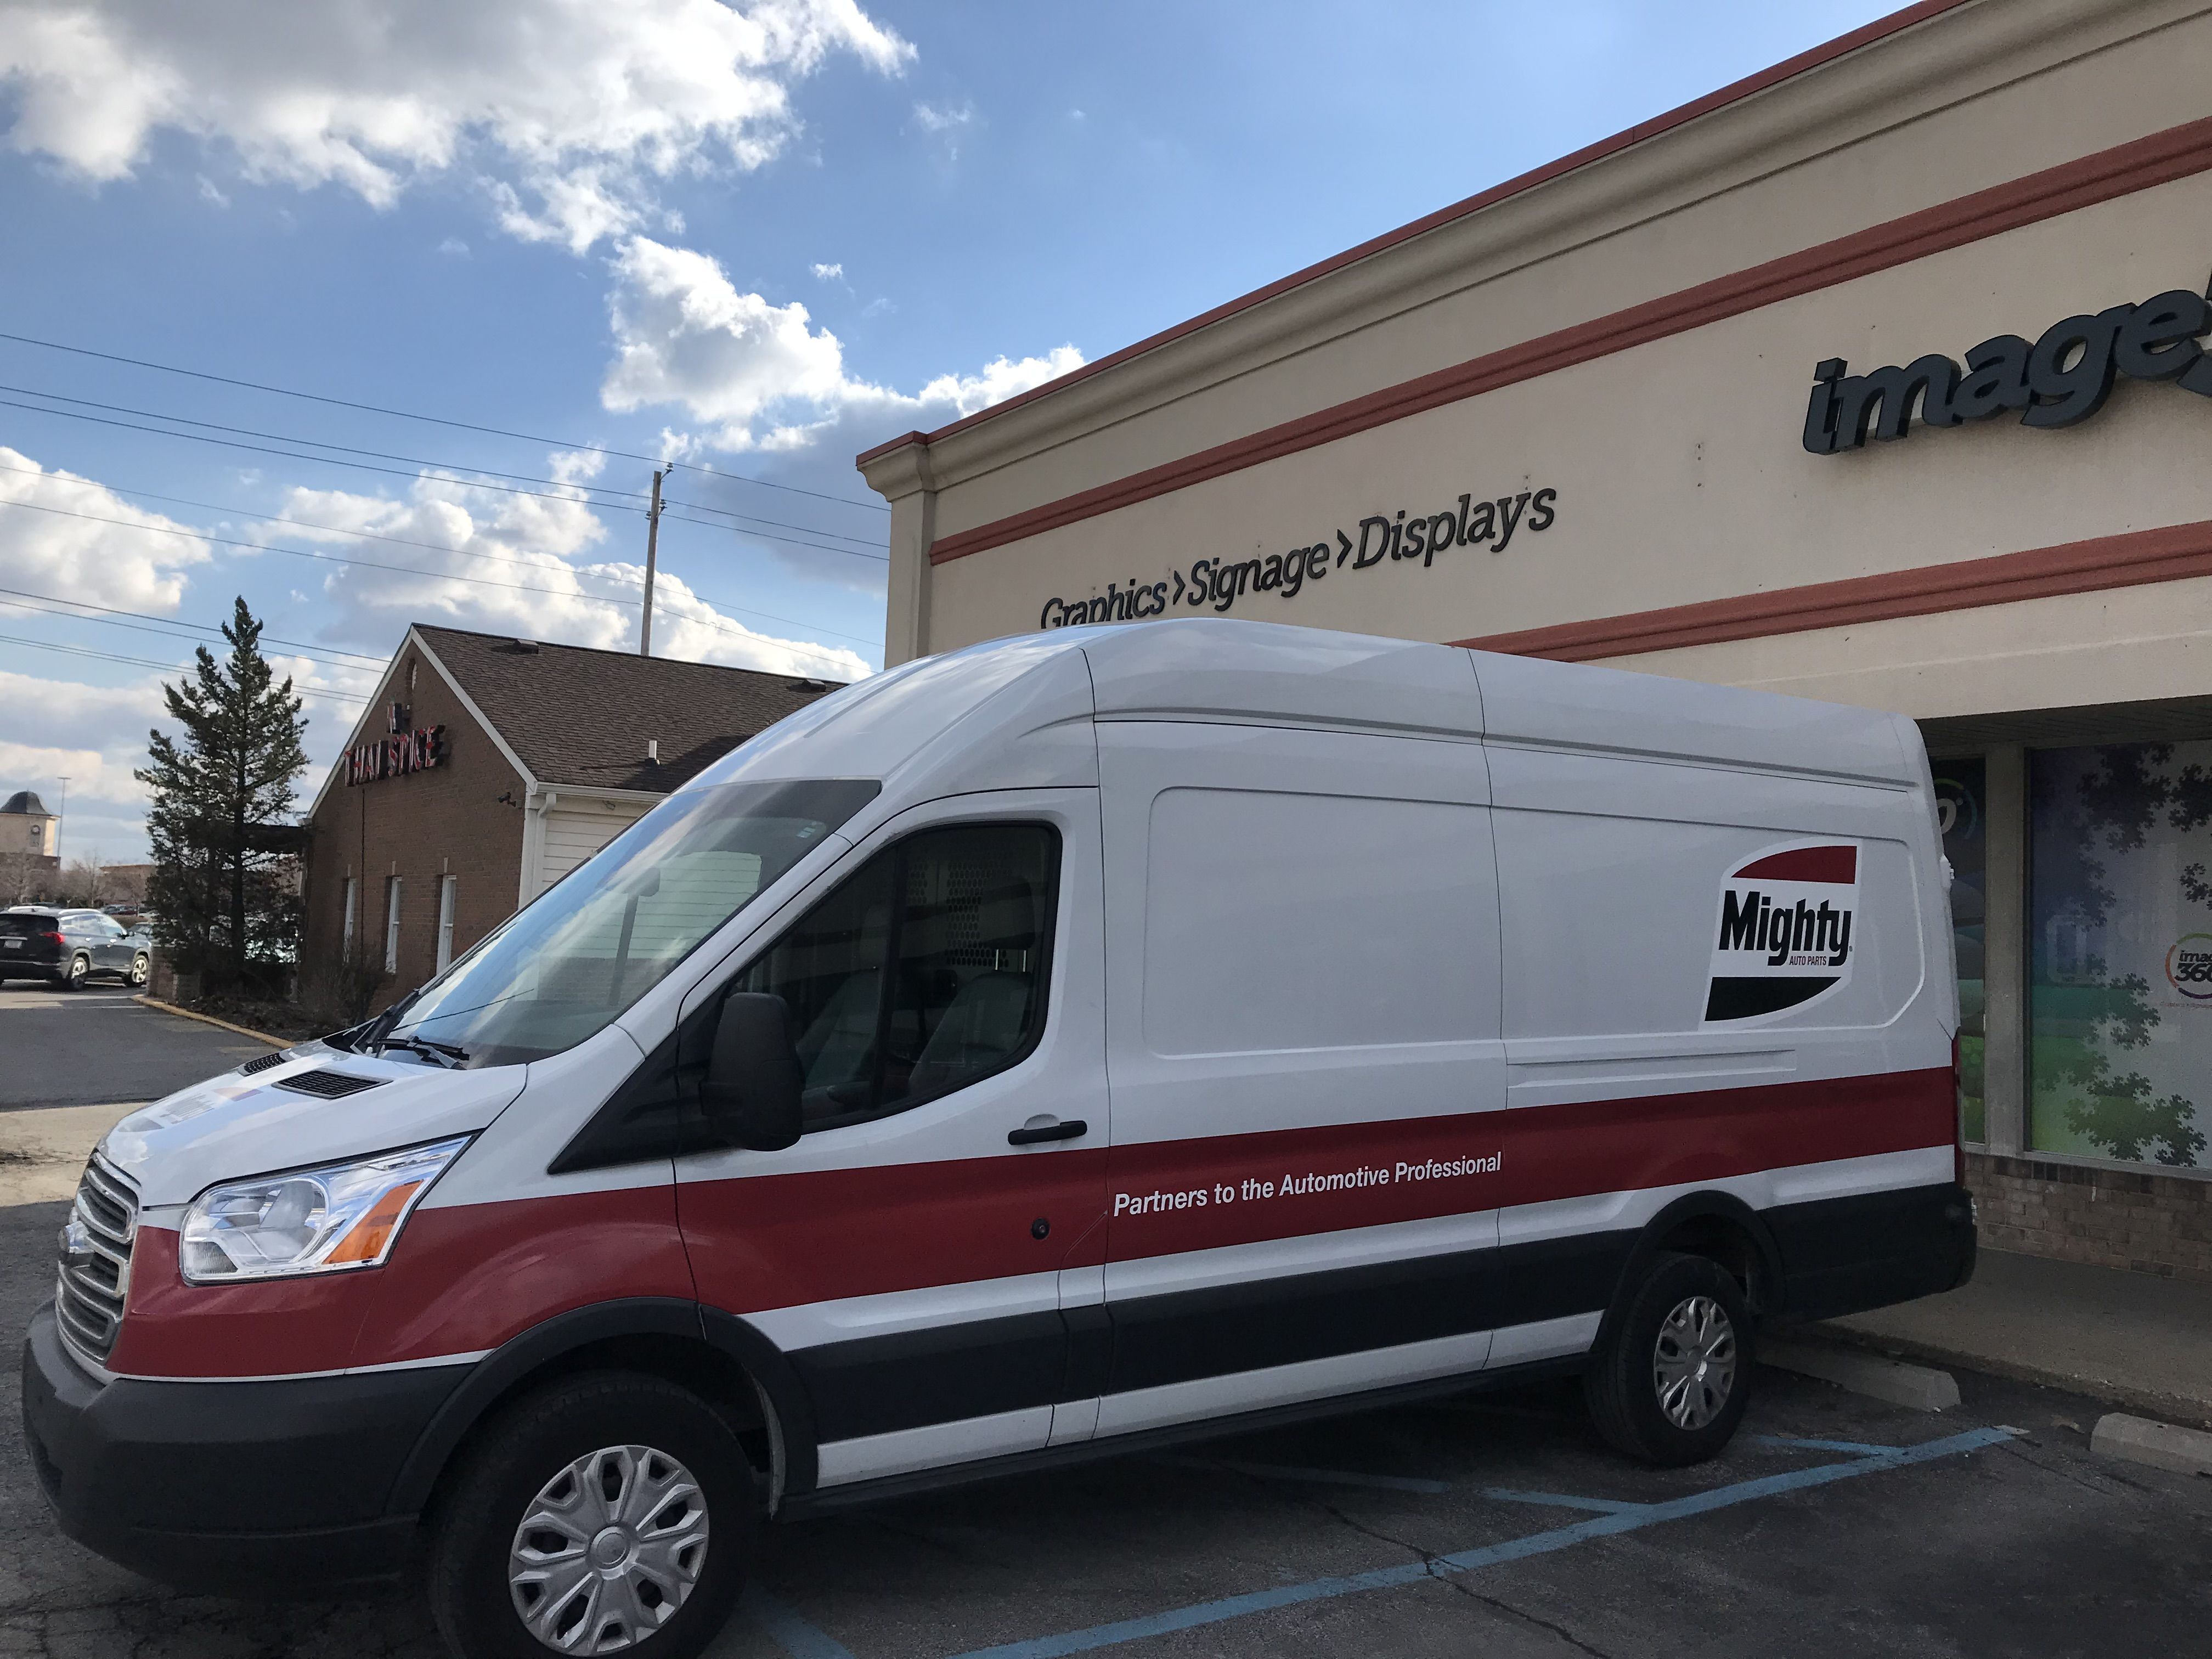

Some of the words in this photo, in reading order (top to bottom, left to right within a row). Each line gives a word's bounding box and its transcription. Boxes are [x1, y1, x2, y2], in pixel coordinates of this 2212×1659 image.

[1803, 269, 2212, 455] image
[1041, 578, 1167, 629] Graphics
[1187, 543, 1330, 611] Signage
[1352, 487, 1557, 570] Displays
[1718, 890, 1852, 967] Mighty
[1789, 956, 1806, 966] AUTO
[1807, 956, 1827, 966] PARTS
[1113, 1187, 1207, 1217] Partners
[1214, 1182, 1235, 1204] to
[1241, 1177, 1274, 1201] the
[1279, 1165, 1390, 1197] Automotive
[1394, 1151, 1502, 1183] Professional
